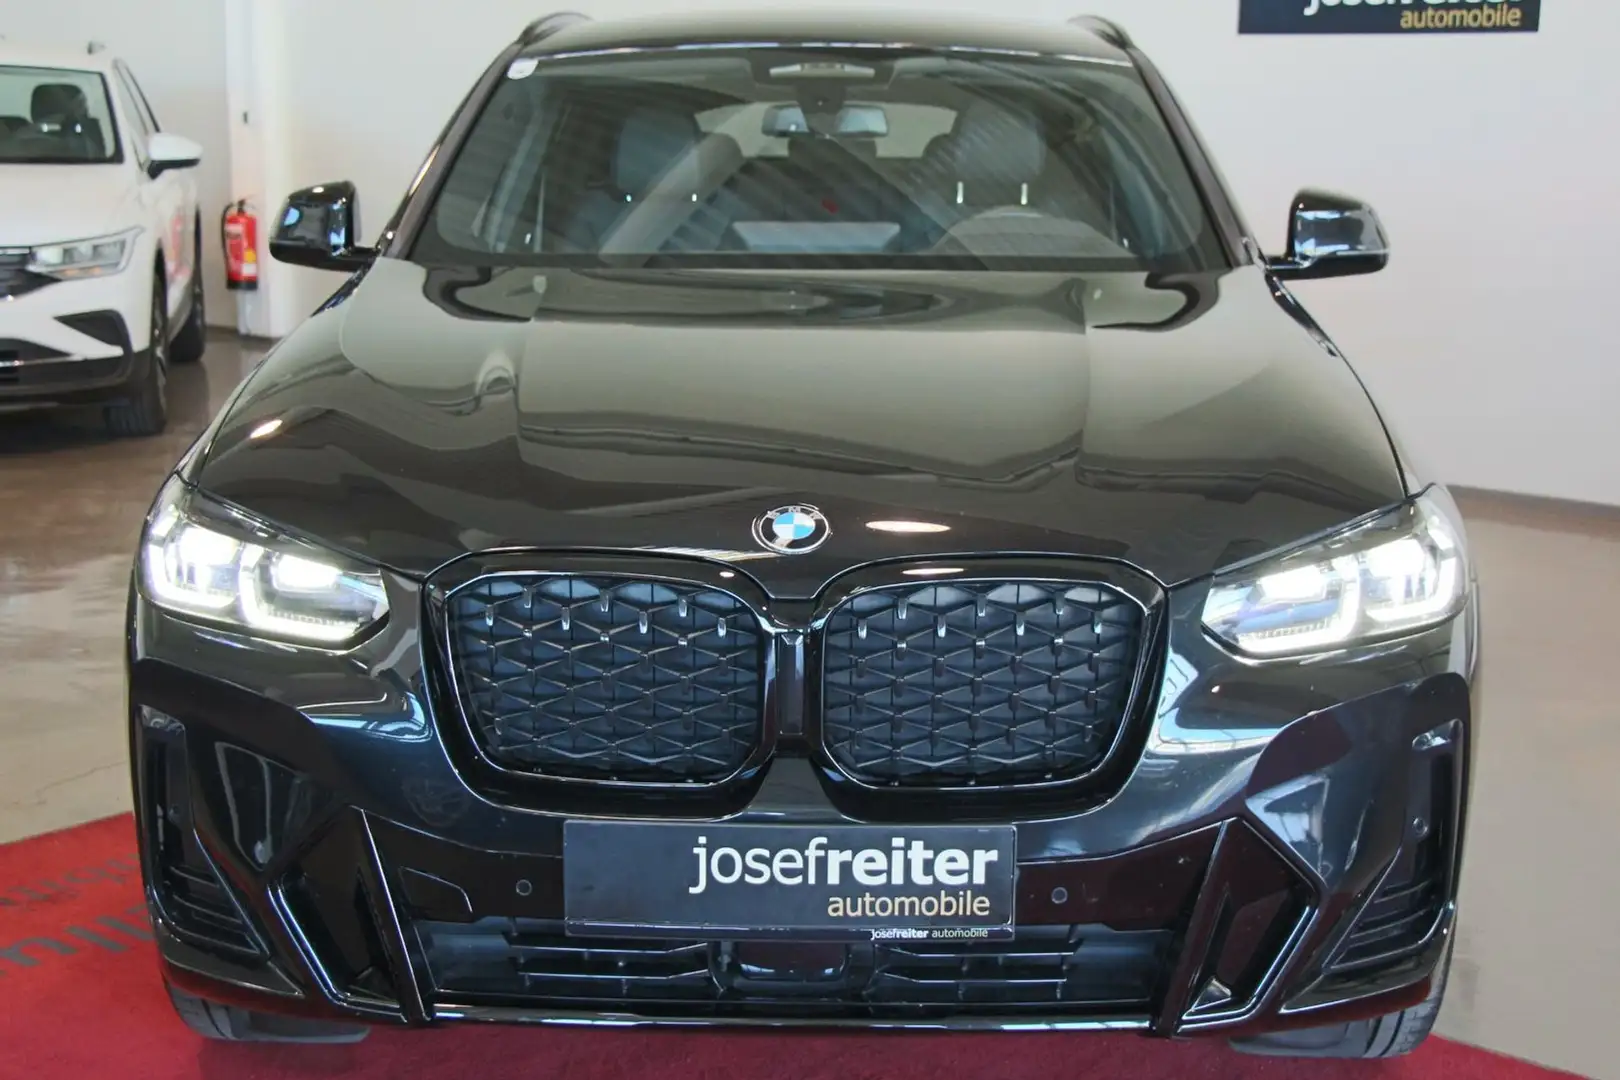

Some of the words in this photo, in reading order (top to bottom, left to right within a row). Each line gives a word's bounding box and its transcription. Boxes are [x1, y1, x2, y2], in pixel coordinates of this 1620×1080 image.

[1400, 4, 1521, 28] automobile
[688, 836, 998, 894] josefreiter
[827, 890, 990, 917] automobile
[870, 928, 929, 941] josefreiter
[931, 927, 989, 938] automobile
